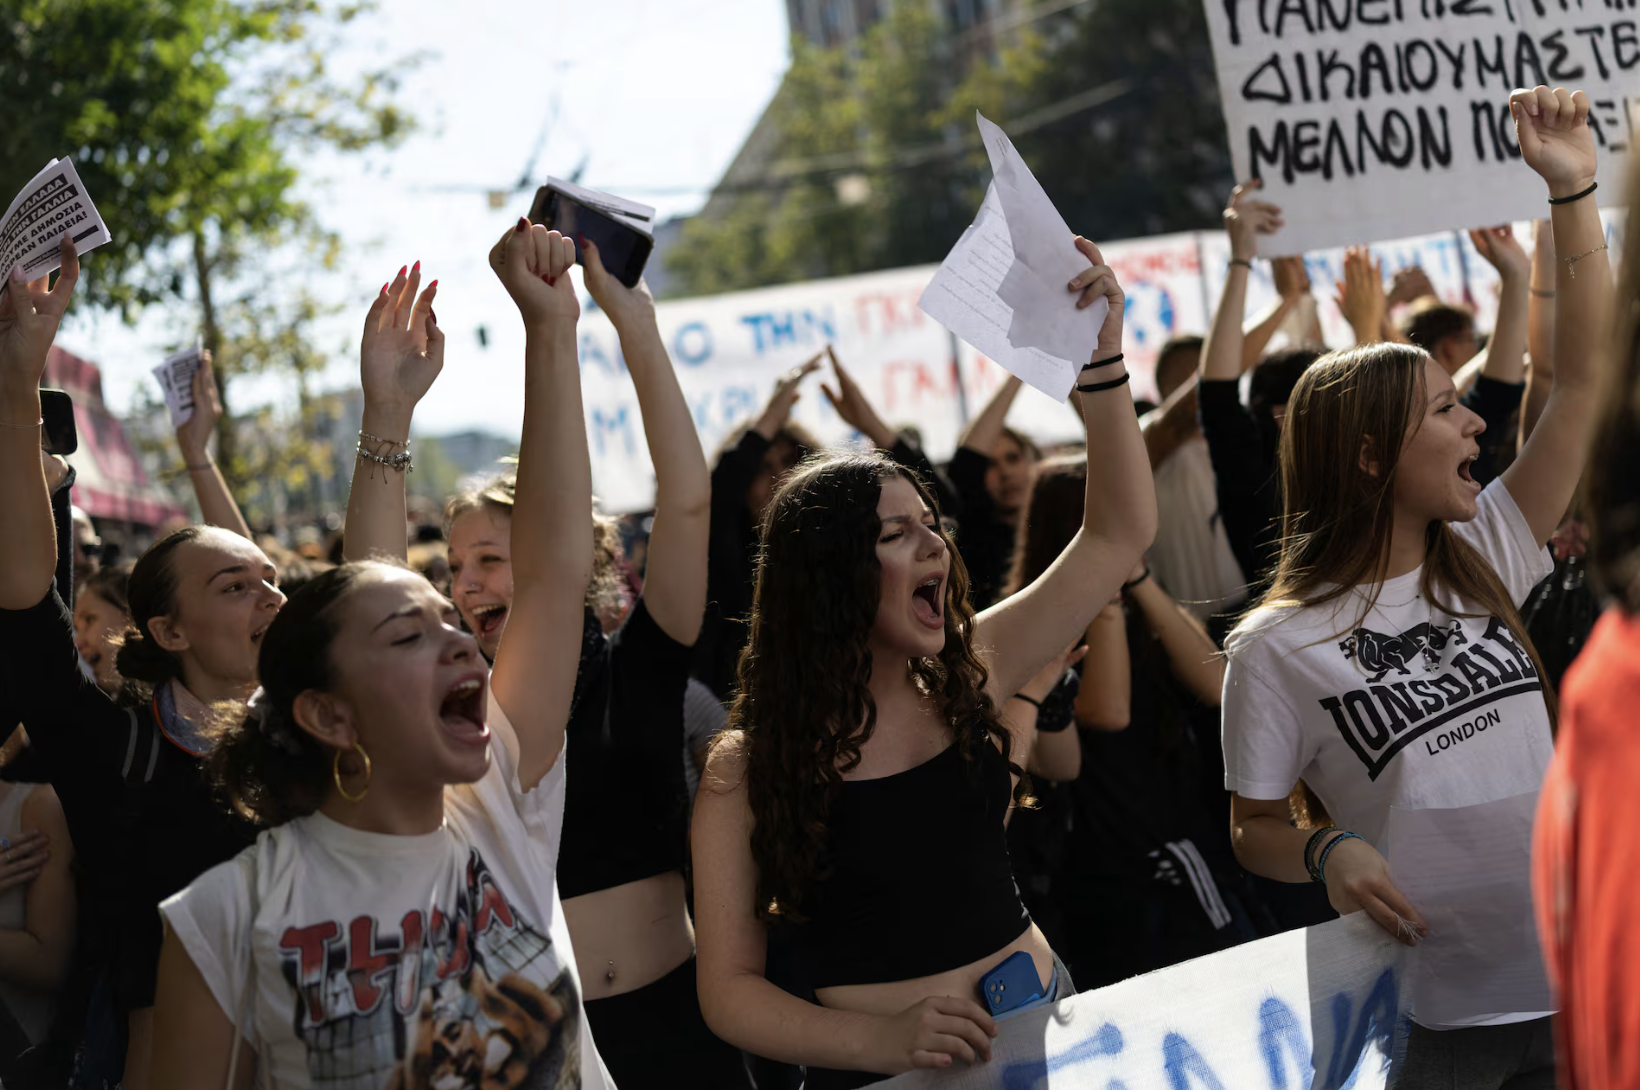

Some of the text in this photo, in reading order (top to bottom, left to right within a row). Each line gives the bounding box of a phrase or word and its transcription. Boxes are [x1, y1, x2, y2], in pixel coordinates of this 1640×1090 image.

[1248, 104, 1453, 189] ΜΕΛΛΟΝ
[19, 178, 64, 215] ΕΛΛΑΔΑ
[31, 190, 74, 221] ΓΑΛΛΙΑ
[30, 201, 83, 238] ΔΗΜΟΣΙΑ
[38, 210, 88, 245] ΠΑΙΔΕΙΑ!
[1318, 616, 1540, 782] LONSDALE
[1425, 708, 1501, 756] LONDON
